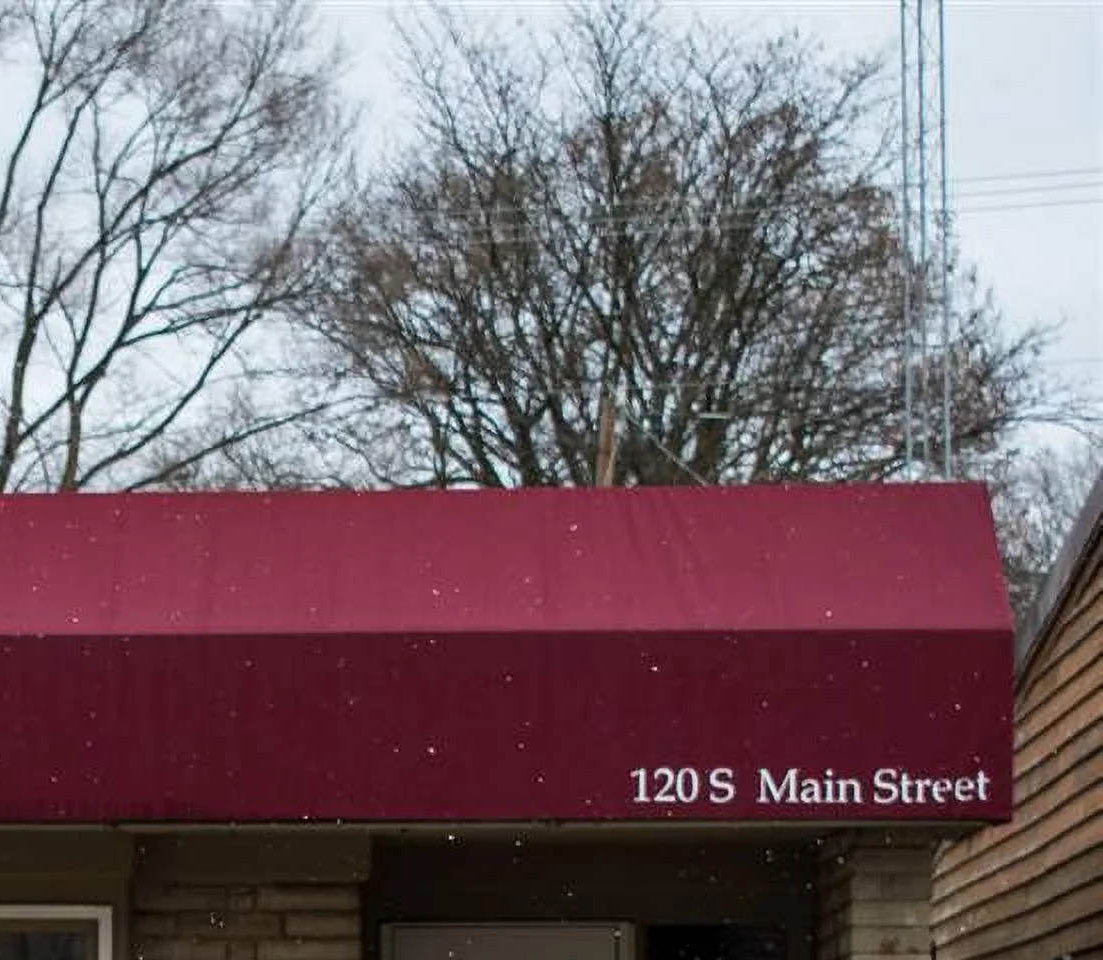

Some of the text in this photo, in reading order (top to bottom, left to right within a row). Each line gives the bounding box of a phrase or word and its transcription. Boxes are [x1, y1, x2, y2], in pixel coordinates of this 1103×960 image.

[630, 767, 990, 804] 120 S Main Street
